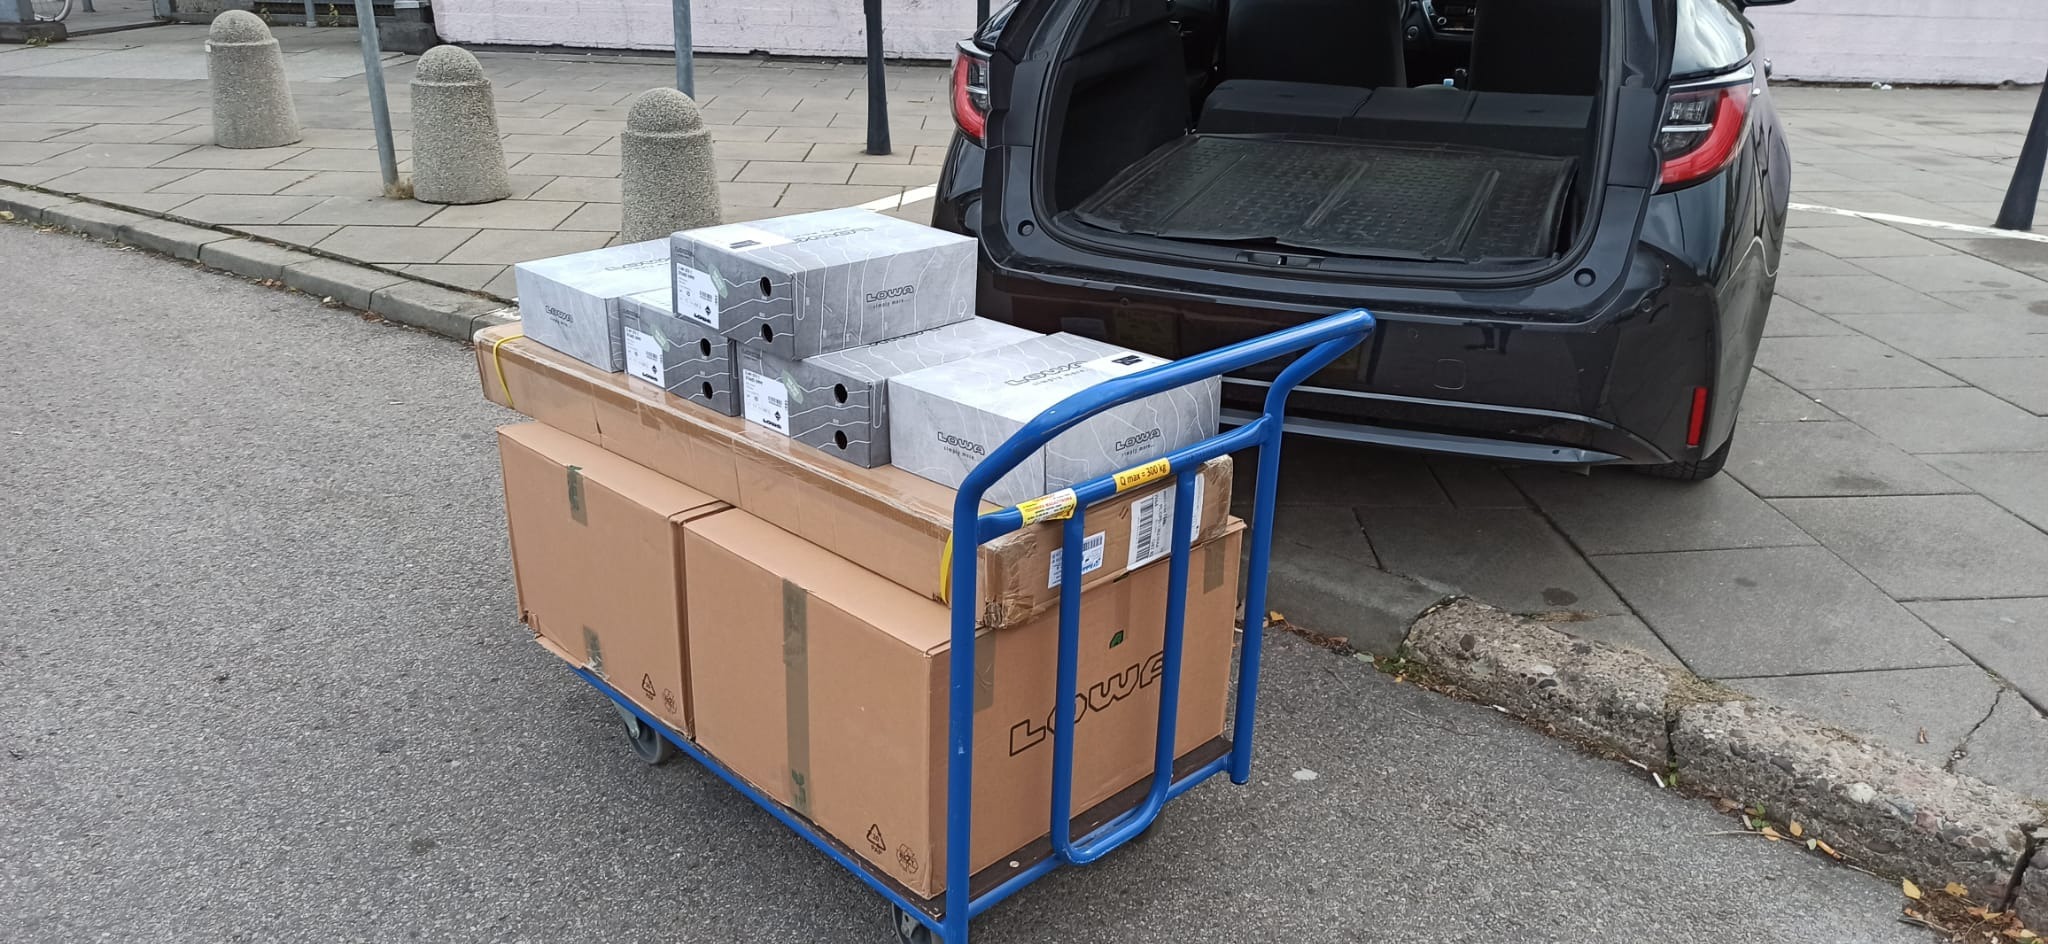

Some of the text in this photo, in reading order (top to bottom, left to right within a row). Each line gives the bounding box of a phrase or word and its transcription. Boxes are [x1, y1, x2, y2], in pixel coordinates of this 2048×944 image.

[866, 284, 914, 303] LOWA
[1004, 360, 1088, 386] LOWA
[937, 431, 985, 456] LOWA
[1115, 428, 1161, 452] LOWA
[1120, 476, 1126, 486] Q
[1127, 473, 1140, 483] max
[1146, 465, 1158, 477] 300
[1158, 463, 1167, 474] kg
